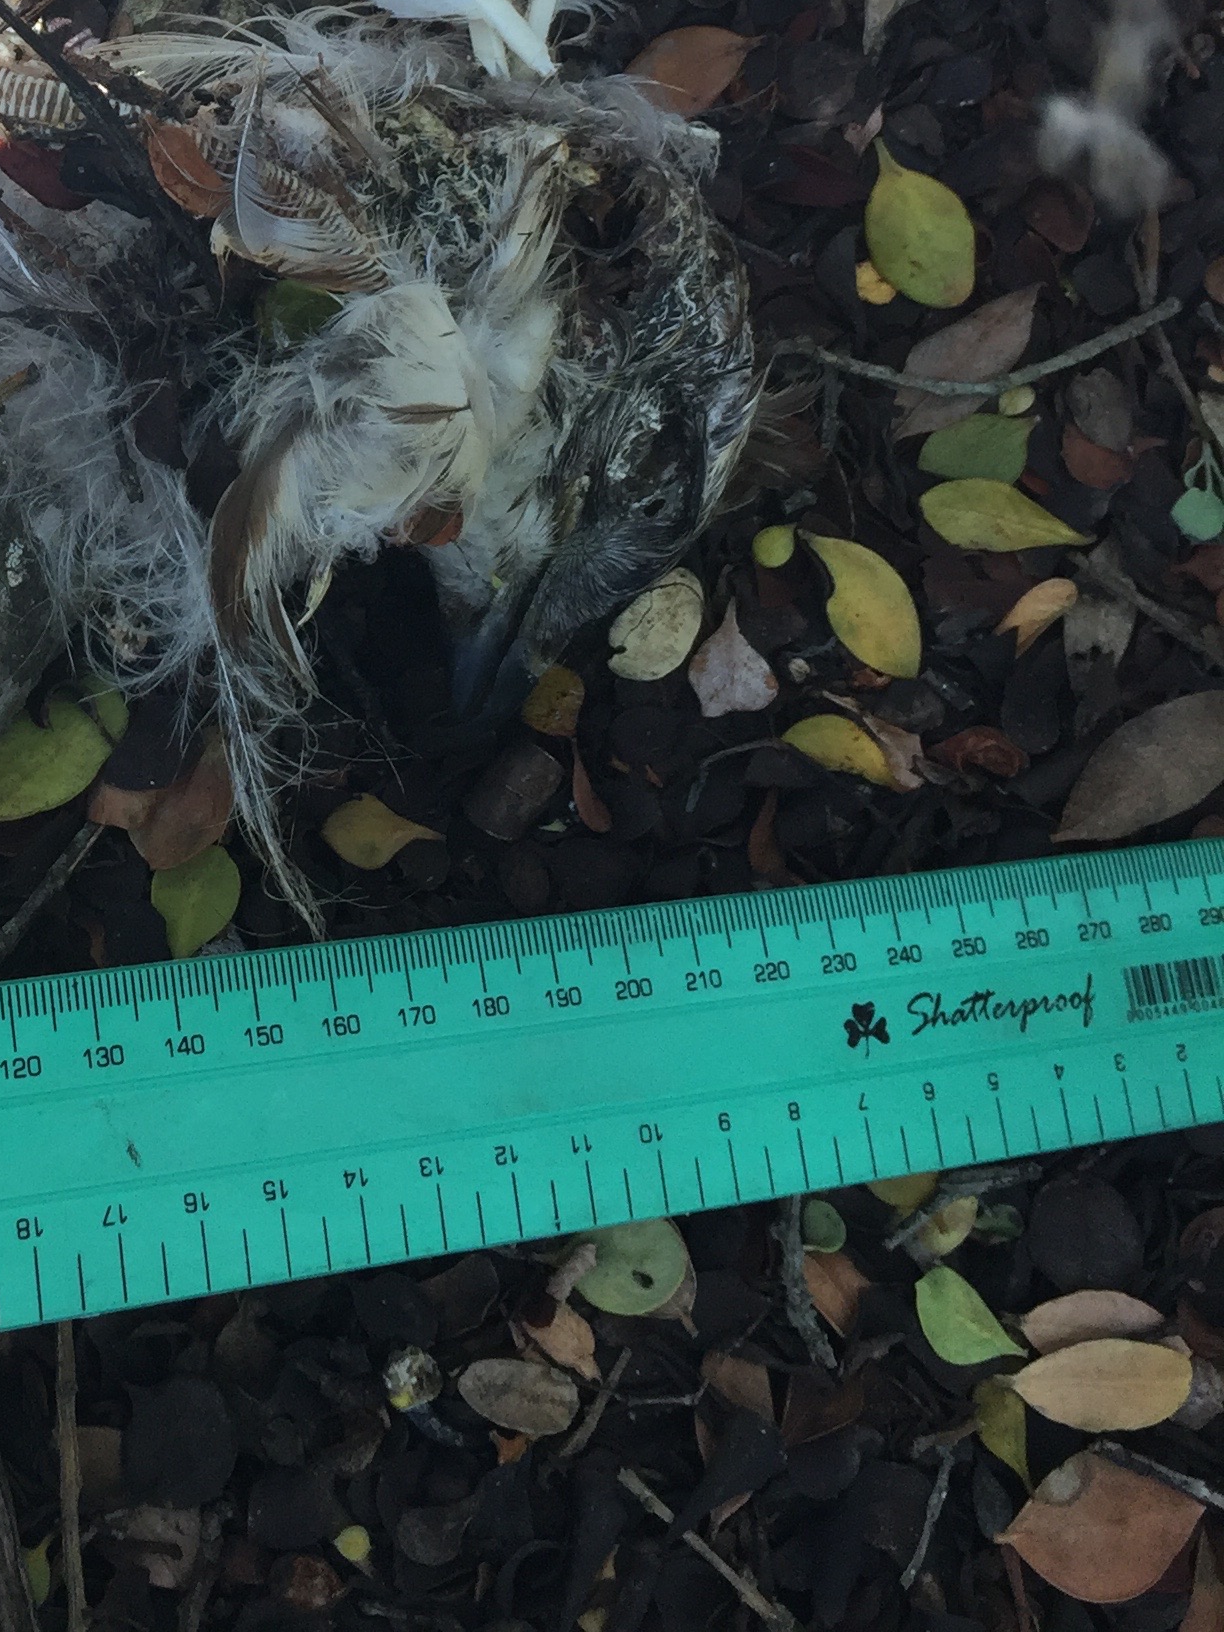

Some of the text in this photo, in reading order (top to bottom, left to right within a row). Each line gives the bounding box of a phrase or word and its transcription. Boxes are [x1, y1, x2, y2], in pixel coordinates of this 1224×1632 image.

[0, 1056, 42, 1080] 120
[83, 1045, 124, 1069] 130
[165, 1034, 206, 1058] 140
[244, 1023, 284, 1047] 150
[321, 1015, 361, 1038] 160
[398, 1005, 437, 1028] 170
[473, 995, 510, 1017] 180
[545, 986, 582, 1008] 190
[615, 977, 653, 1001] 200
[685, 969, 722, 991] 210
[754, 961, 790, 983] 220
[820, 953, 856, 974] 230
[887, 945, 922, 966] 240
[952, 937, 987, 958] 250
[1016, 929, 1050, 949] 260
[1078, 921, 1112, 942] 270
[1139, 913, 1172, 934] 280
[907, 972, 1096, 1035] Shatterproof
[1113, 1053, 1126, 1072] 3
[1176, 1044, 1188, 1062] 2
[987, 1073, 999, 1091] 5
[1054, 1064, 1064, 1080] 4
[923, 1082, 935, 1101] 6
[788, 1102, 800, 1121] 8
[858, 1093, 868, 1111] 7
[718, 1113, 731, 1132] 9
[571, 1134, 592, 1153] 11
[639, 1124, 663, 1144] 10
[494, 1145, 518, 1165] 12
[419, 1157, 445, 1177] 13
[343, 1168, 369, 1189] 14
[262, 1180, 289, 1201] 15
[183, 1193, 210, 1213] 16
[102, 1205, 128, 1226] 17
[16, 1218, 43, 1240] 18
